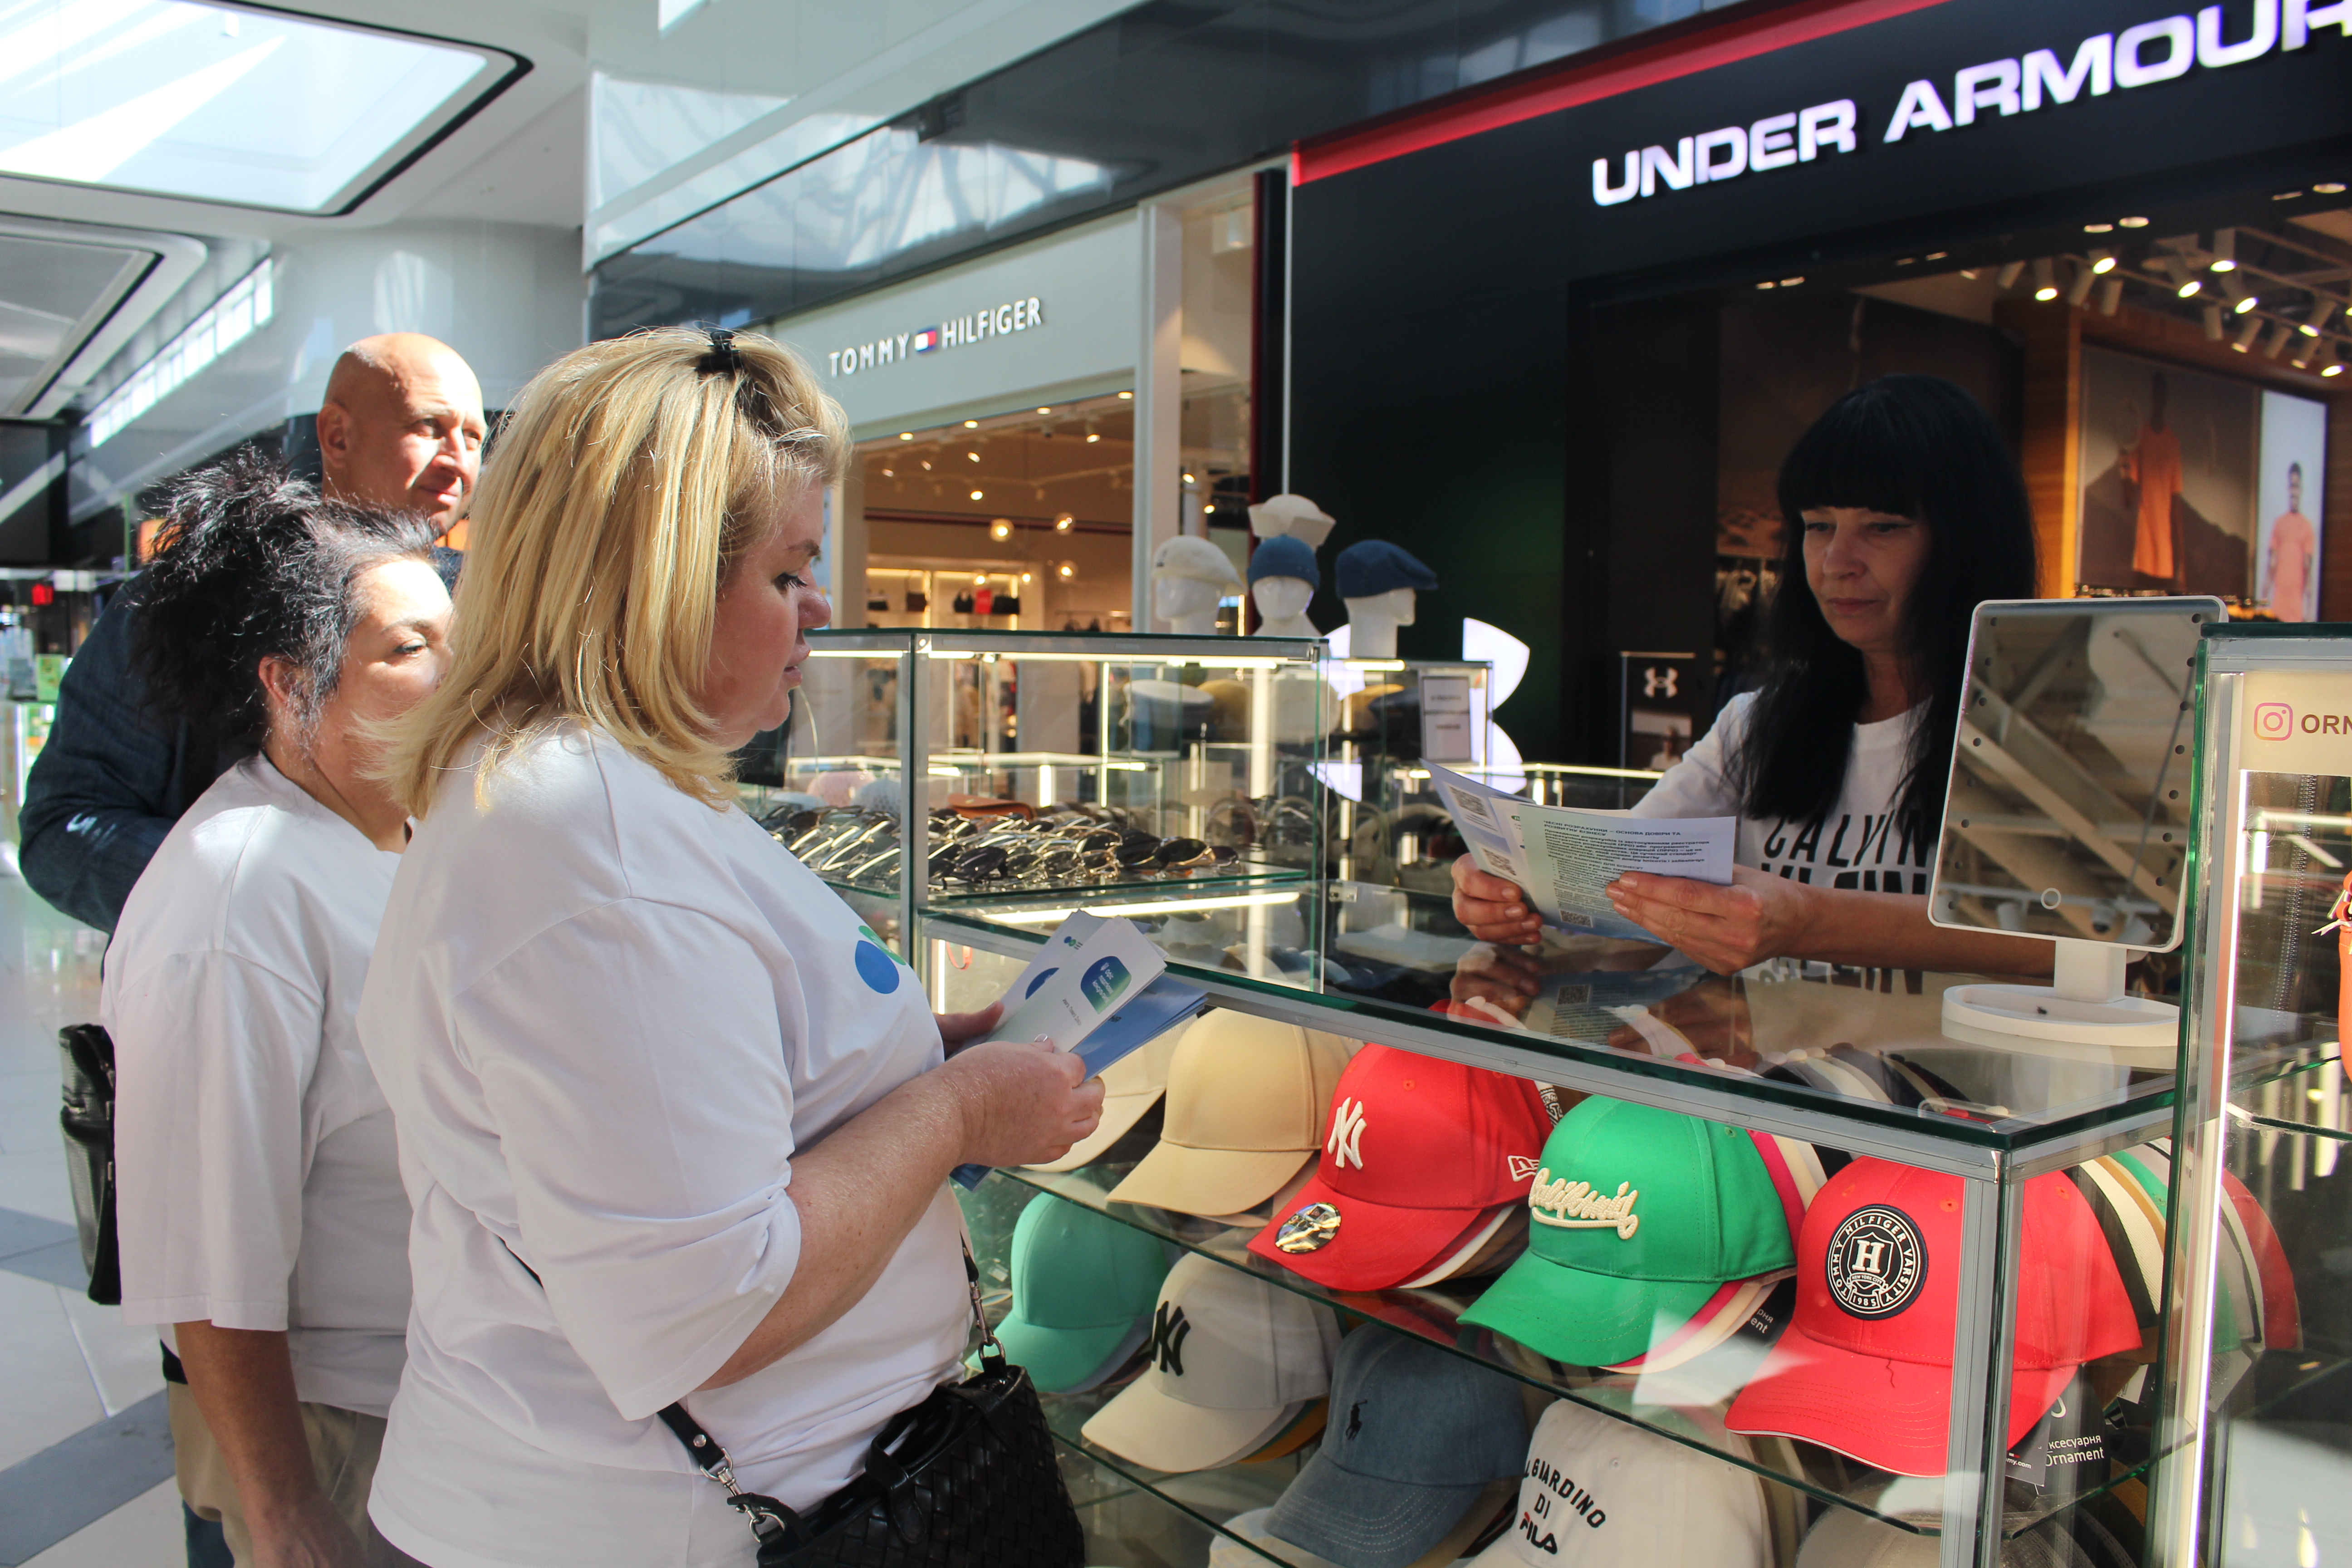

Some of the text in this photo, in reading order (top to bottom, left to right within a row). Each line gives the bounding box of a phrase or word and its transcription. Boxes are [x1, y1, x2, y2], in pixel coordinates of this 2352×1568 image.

[1592, 98, 1856, 206] UNDER
[828, 296, 1042, 378] TOMMY HILFIGER
[1564, 824, 1607, 833] РОЗРАХУНКИ
[1833, 1216, 1914, 1302] TOMMY HILFIGER VARSITY
[1852, 1239, 1885, 1274] H
[1852, 1295, 1877, 1307] 1985
[2047, 1435, 2102, 1450] ксесуарня
[1531, 1458, 1606, 1529] GIARDINO
[1534, 1493, 1551, 1519] DI
[1519, 1511, 1558, 1555] FILA
